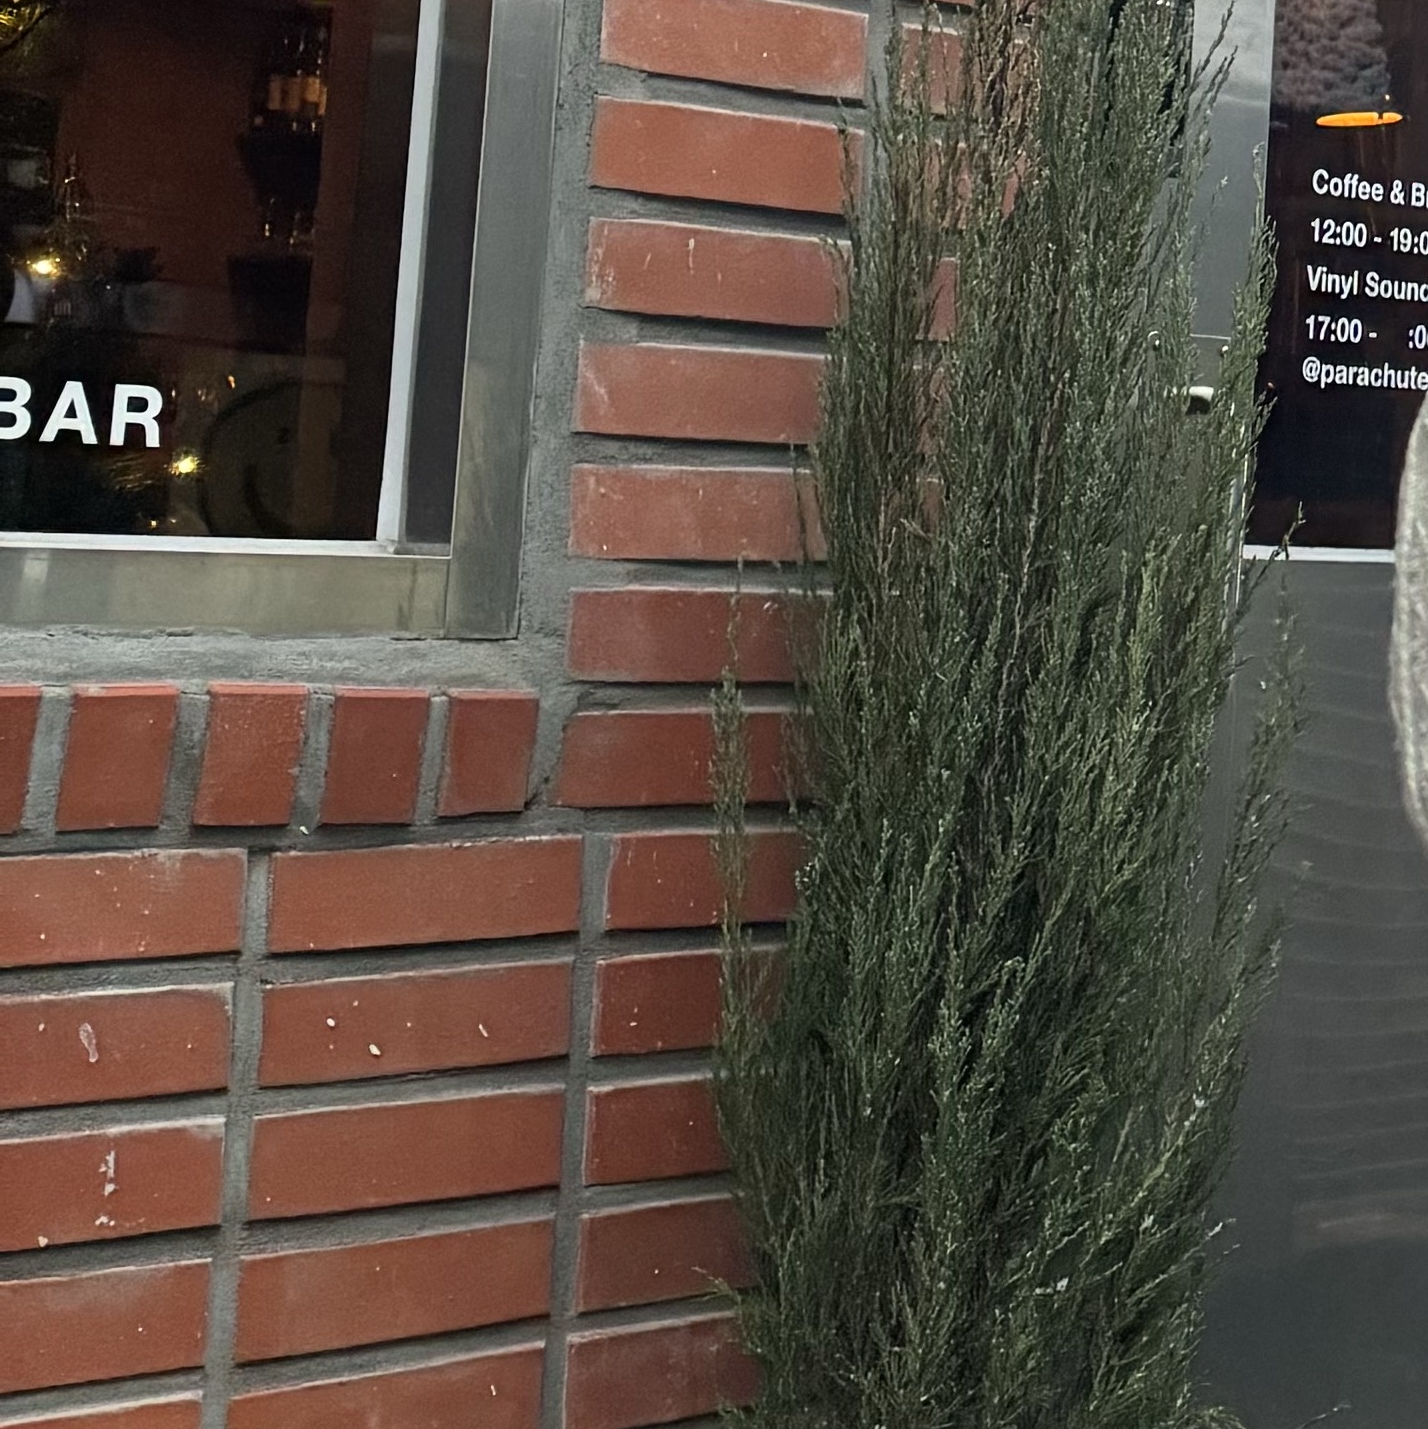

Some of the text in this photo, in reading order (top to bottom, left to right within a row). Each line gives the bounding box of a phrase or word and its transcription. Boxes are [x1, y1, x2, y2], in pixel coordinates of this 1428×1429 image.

[1312, 169, 1384, 202] Coffee
[1390, 180, 1405, 206] &
[1311, 218, 1367, 248] 12:00
[1307, 265, 1359, 299] Vinyl
[1305, 315, 1363, 343] 17:00
[0, 375, 163, 448] BAR
